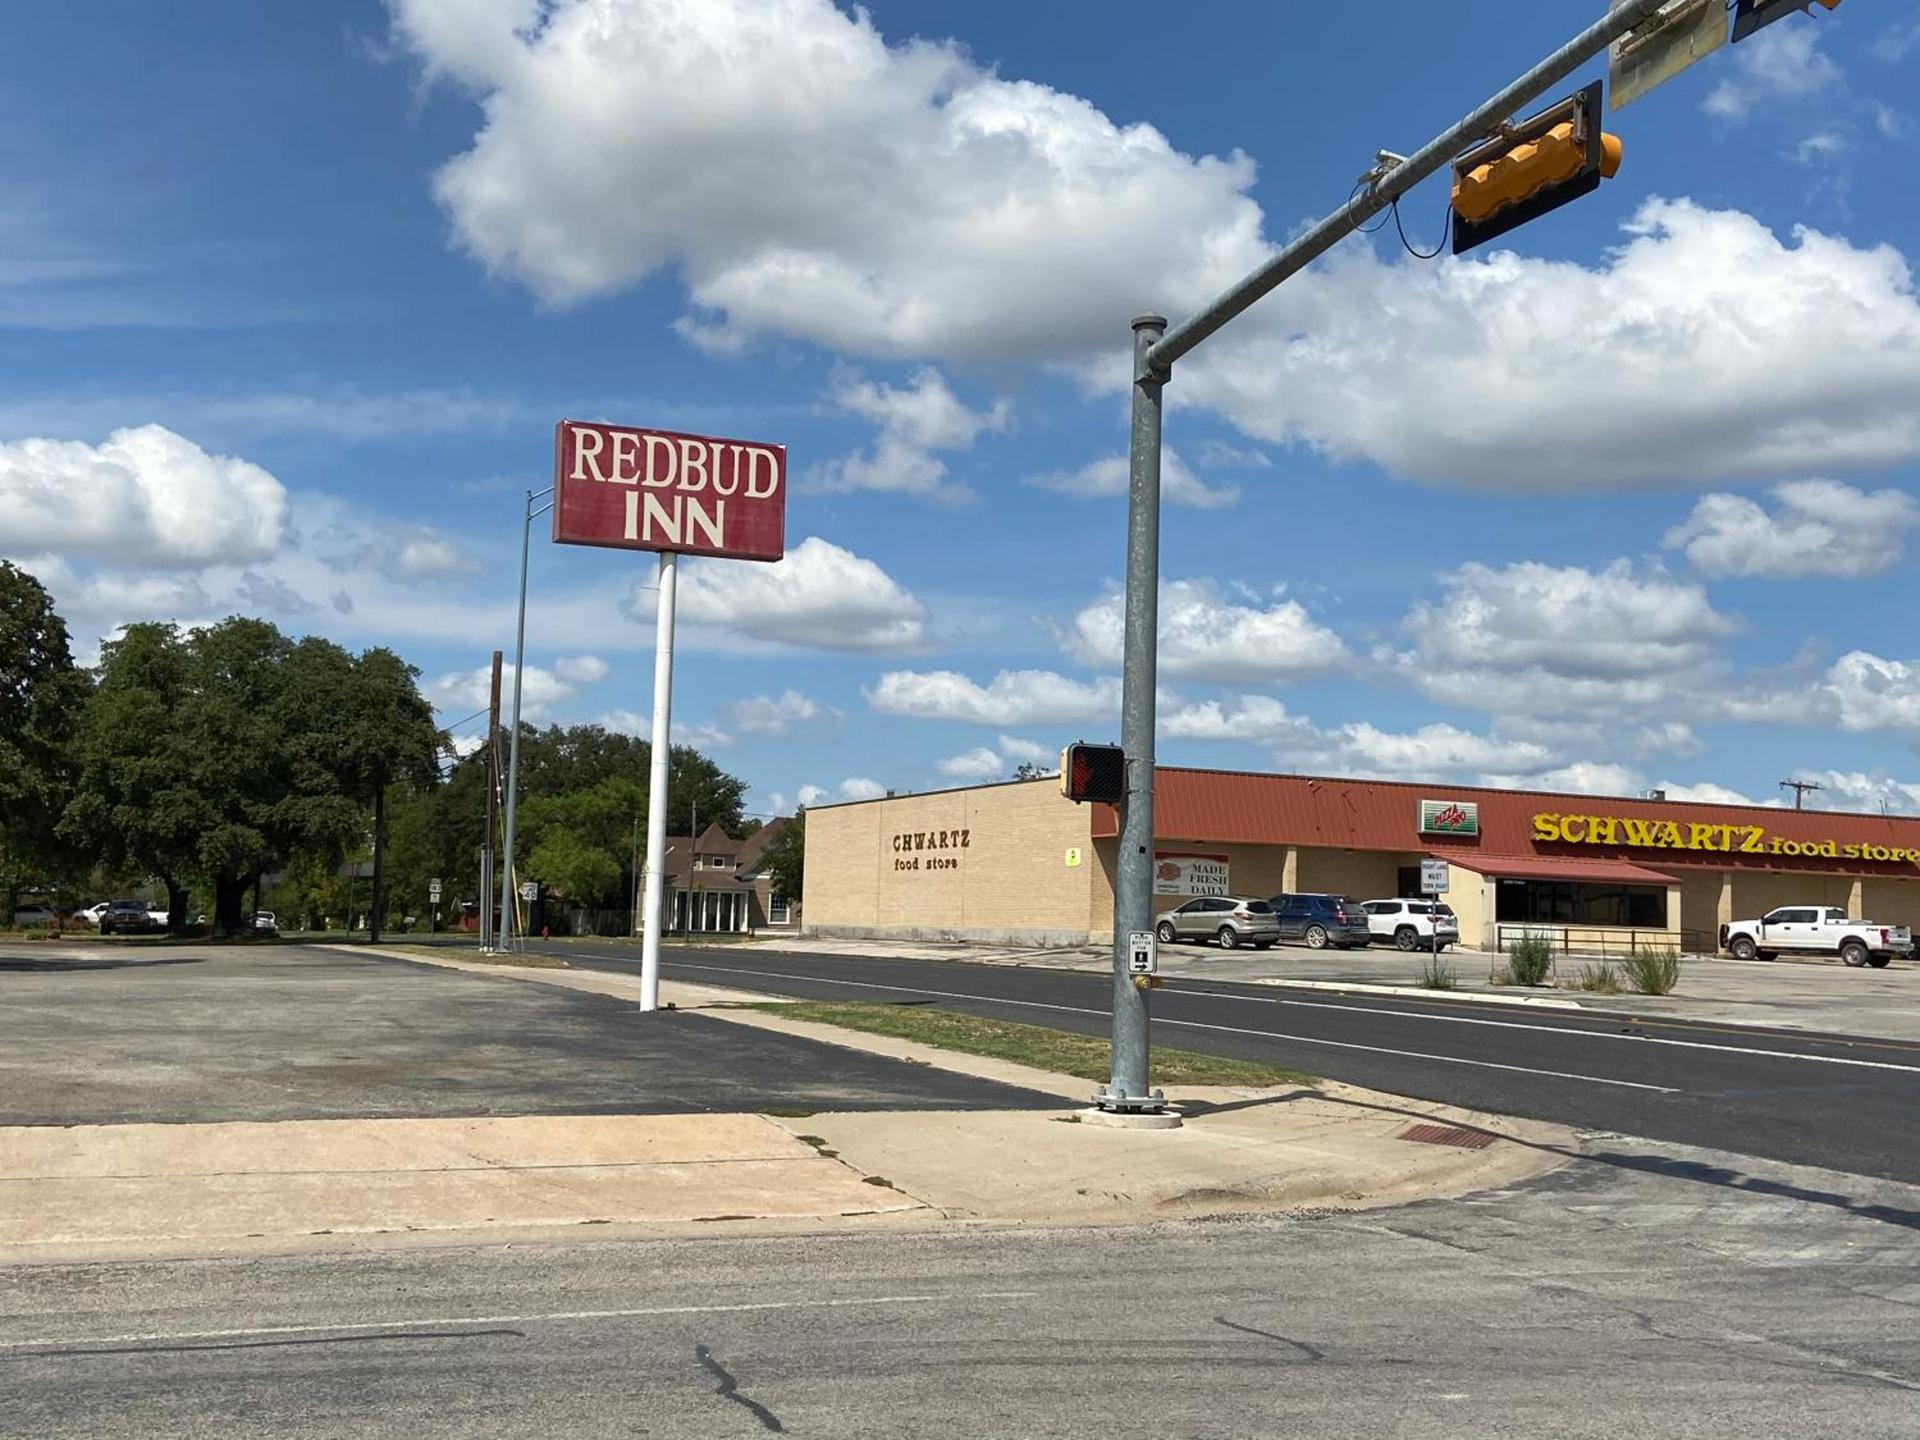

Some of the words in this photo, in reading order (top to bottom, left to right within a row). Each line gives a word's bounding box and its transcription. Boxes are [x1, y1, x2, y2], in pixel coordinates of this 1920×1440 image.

[570, 427, 779, 499] REDBUD
[624, 491, 724, 548] INN
[893, 829, 971, 852] CHWARTZ
[1533, 812, 1764, 853] SCHWARTZ
[1771, 836, 1837, 858] food
[1842, 842, 1920, 863] store
[894, 857, 919, 871] food
[926, 857, 959, 870] store
[1192, 863, 1226, 875] MADE
[1189, 873, 1227, 885] FRESH
[1191, 885, 1224, 896] DAILY
